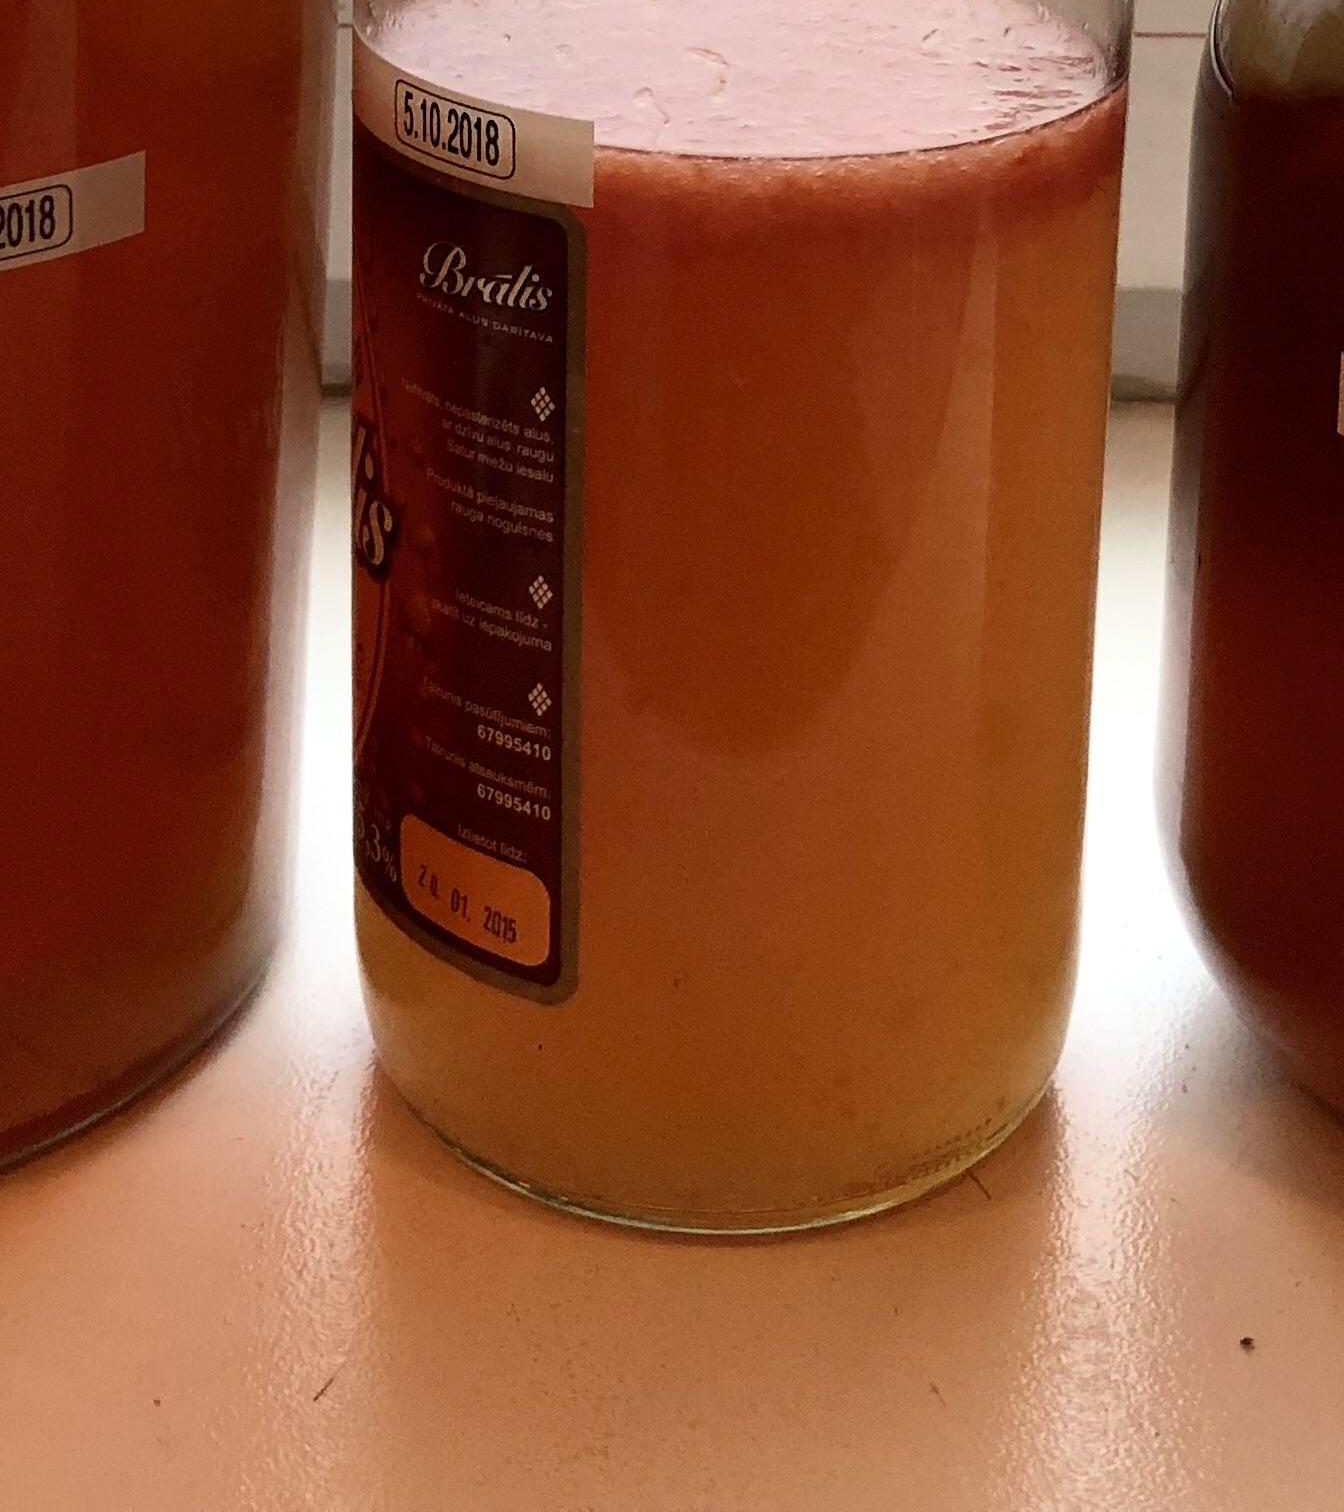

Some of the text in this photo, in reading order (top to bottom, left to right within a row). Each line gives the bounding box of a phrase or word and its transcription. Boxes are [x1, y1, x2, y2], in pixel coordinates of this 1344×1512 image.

[402, 90, 500, 167] 5.10.2018
[419, 240, 553, 312] Brālis
[516, 444, 555, 464] raugu
[450, 500, 555, 544] rauga nogulsnes
[476, 723, 552, 762] 67995410
[476, 782, 552, 822] 67995410
[482, 904, 518, 944] 2015
